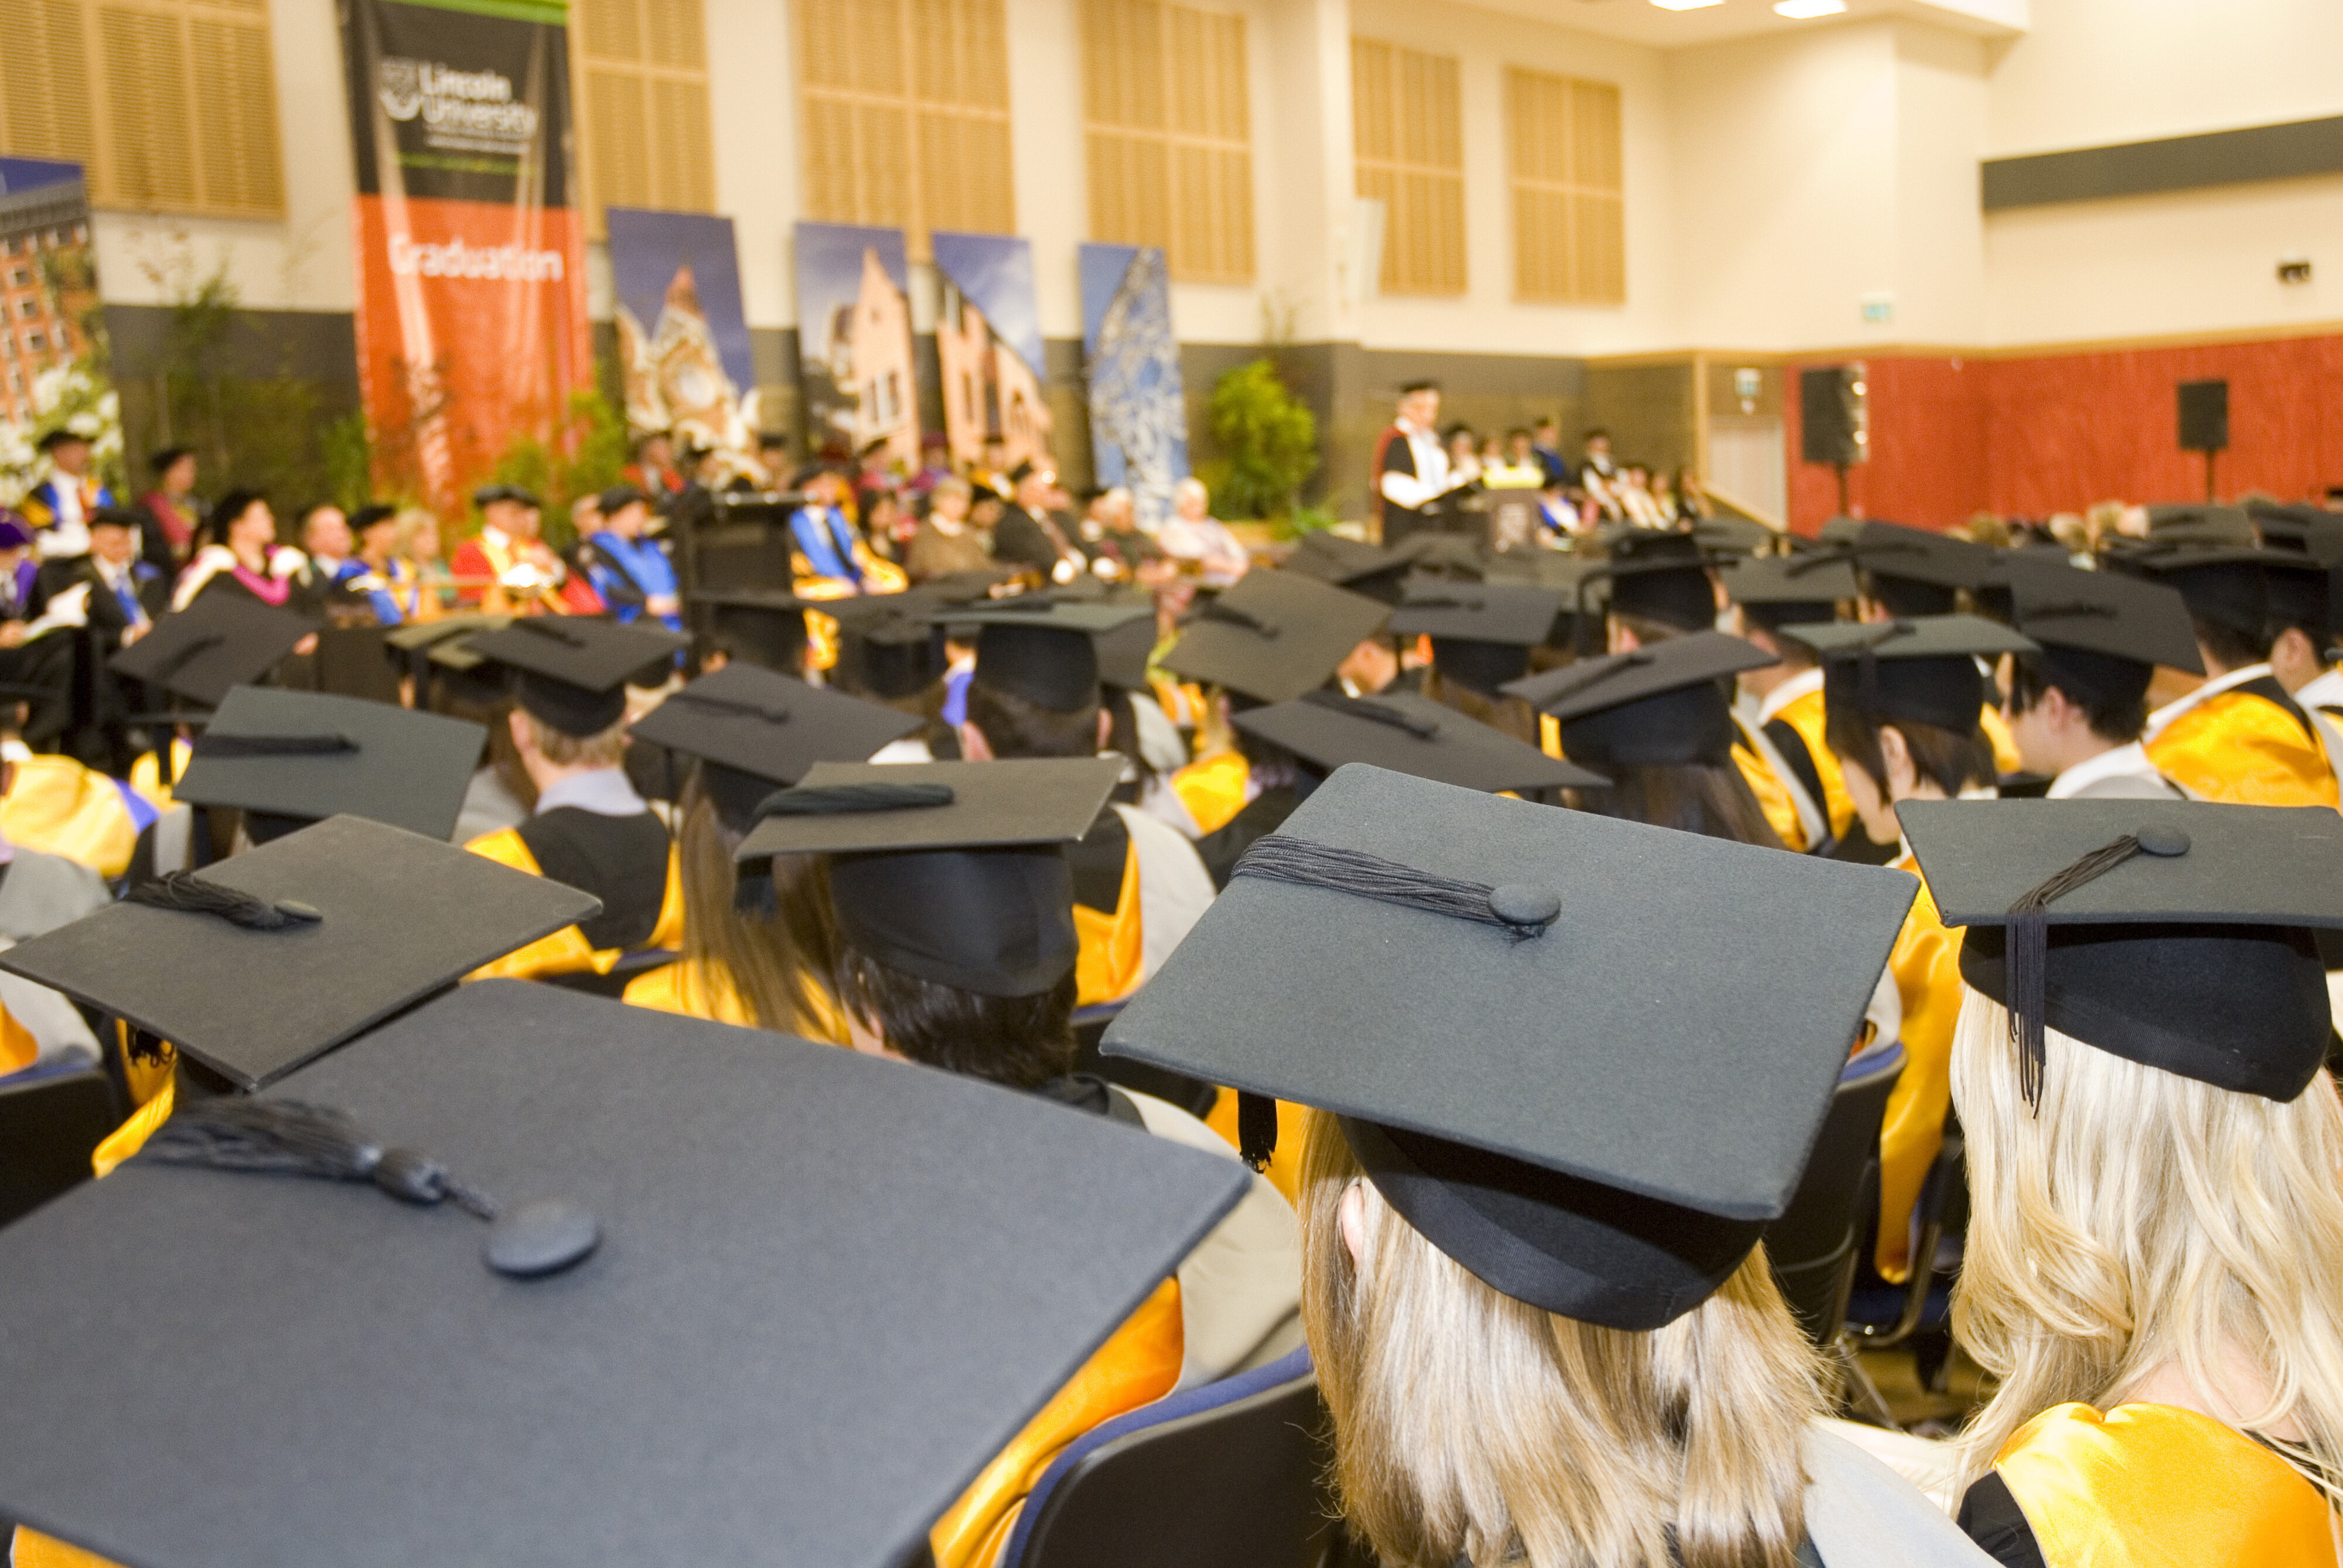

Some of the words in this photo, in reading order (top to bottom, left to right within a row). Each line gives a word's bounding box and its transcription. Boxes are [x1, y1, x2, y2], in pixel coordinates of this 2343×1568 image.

[418, 62, 512, 104] Lincoln
[422, 95, 538, 140] University
[388, 233, 563, 282] Graduation
